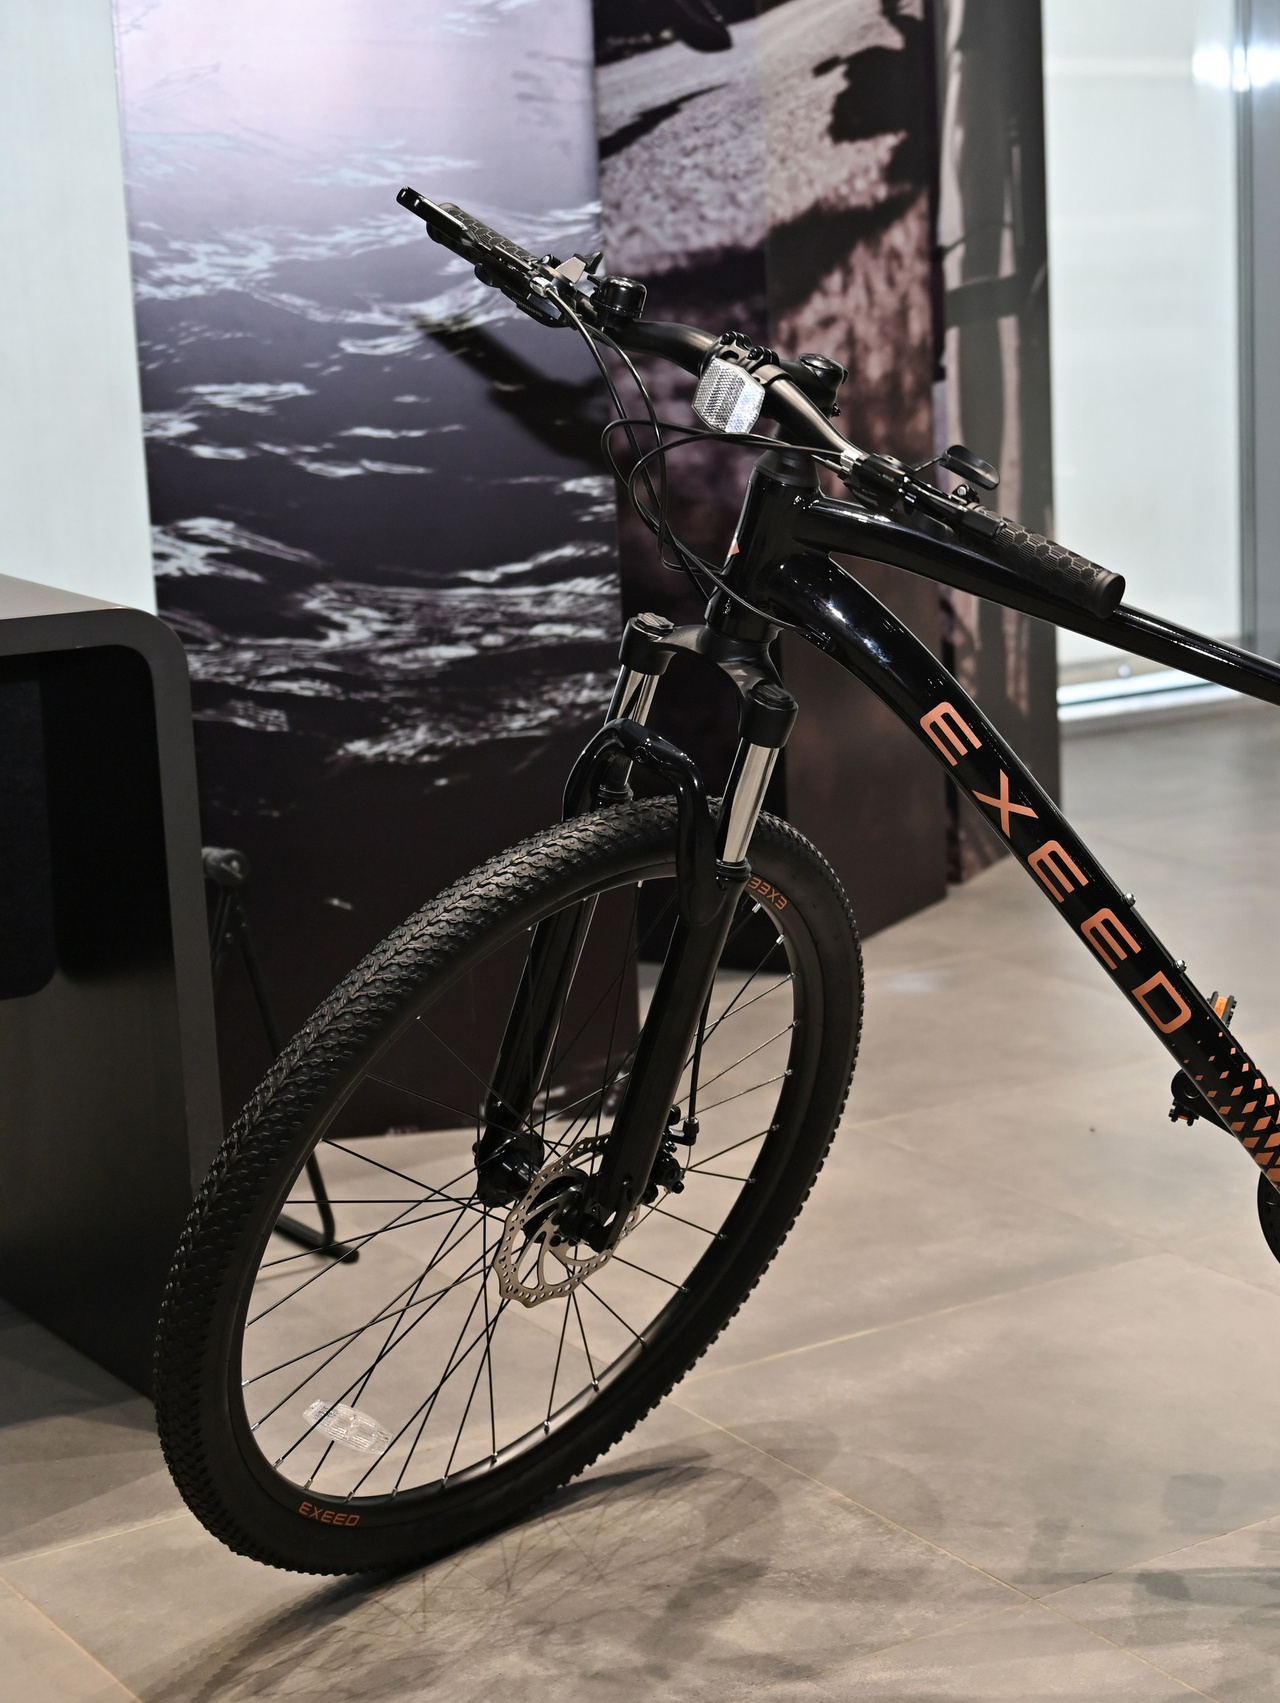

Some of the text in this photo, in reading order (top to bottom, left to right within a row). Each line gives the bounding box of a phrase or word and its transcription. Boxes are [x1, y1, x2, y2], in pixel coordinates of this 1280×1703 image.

[919, 701, 1192, 1034] EXEED
[747, 876, 788, 910] EXEE
[298, 1501, 360, 1526] EXEED
